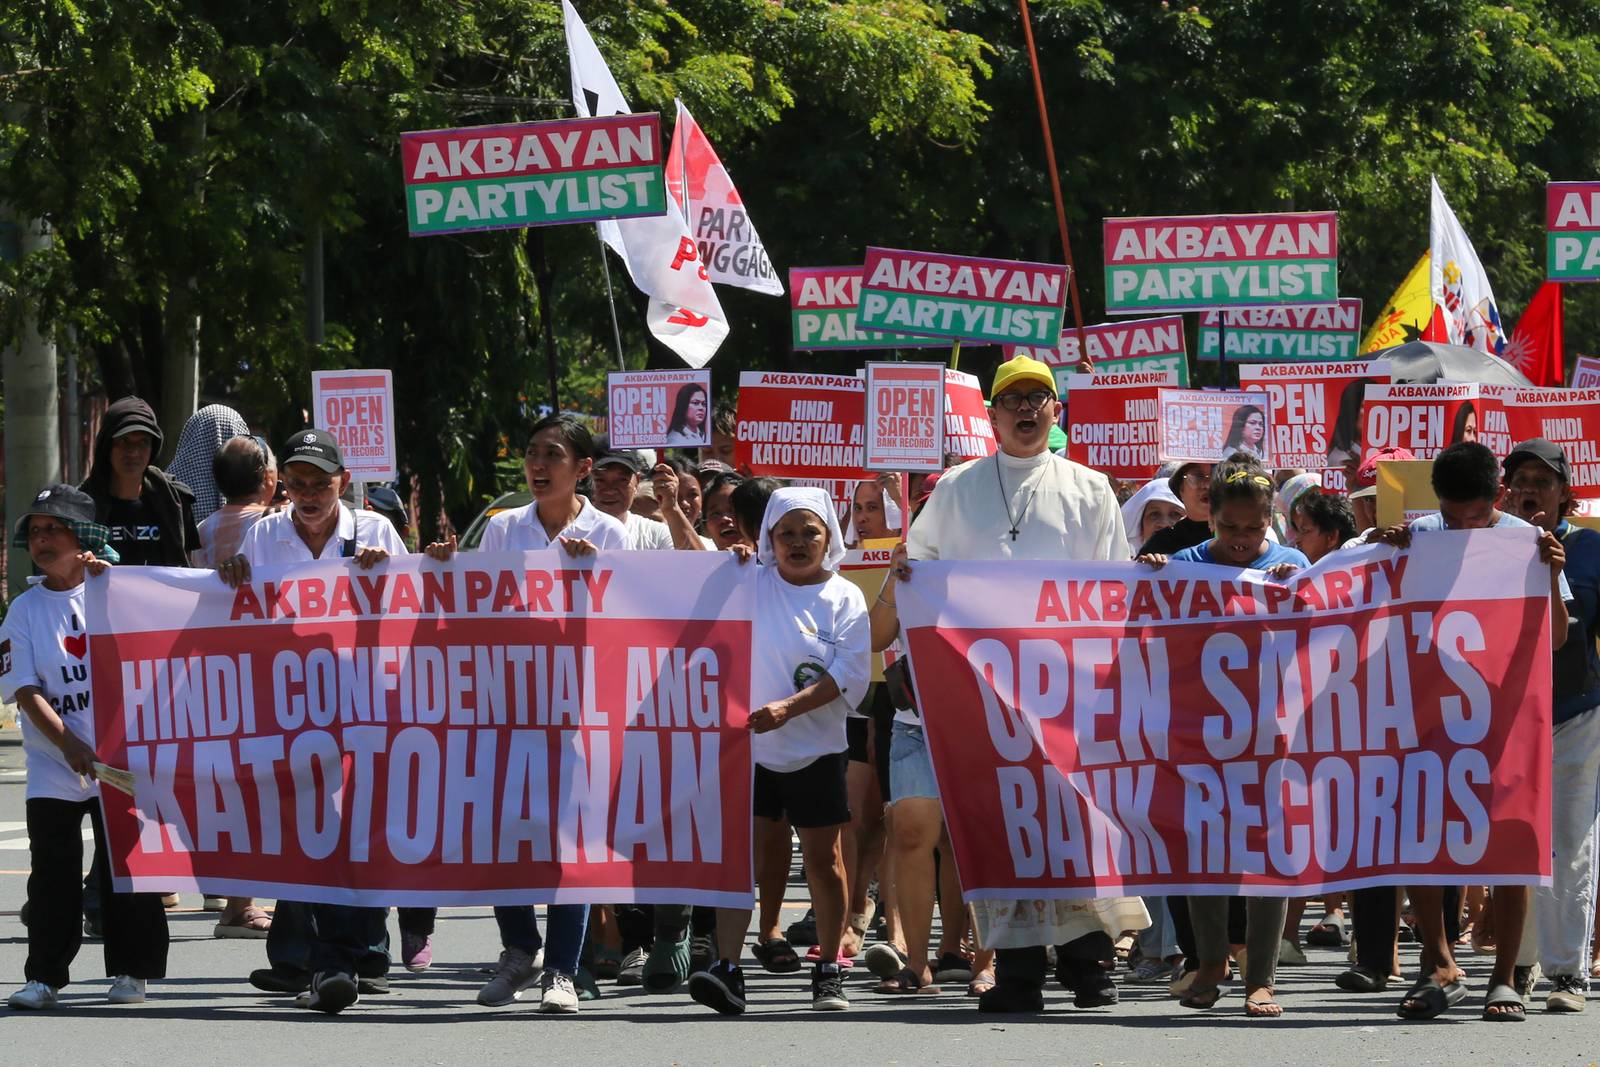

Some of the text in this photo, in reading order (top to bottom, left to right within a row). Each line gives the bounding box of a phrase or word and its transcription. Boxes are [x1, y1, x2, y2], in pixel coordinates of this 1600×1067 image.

[413, 125, 654, 179] AKBAYAN
[414, 172, 655, 225] PARTYLIST
[1555, 192, 1600, 227] A
[697, 207, 751, 243] PAR
[1112, 223, 1330, 261] AKBAYAN
[868, 257, 1061, 304] AKBAYAN
[1113, 264, 1329, 301] PARTYLIST
[863, 294, 1055, 340] PARTYLIST
[1204, 306, 1355, 329] AKBAYAN
[1203, 331, 1354, 357] PARTYLIST
[761, 374, 823, 386] AKBAYAN
[1091, 374, 1149, 386] AKBAYAN
[1150, 372, 1168, 383] PARTY
[1261, 363, 1369, 376] AKBAYAN PARTY
[612, 387, 667, 415] OPEN
[877, 388, 935, 416] OPEN
[1245, 383, 1326, 424] PEN
[1387, 385, 1470, 398] AKBAYAN PARTY
[1515, 392, 1567, 403] AKBAYAN
[326, 395, 384, 426] OPEN
[790, 400, 833, 422] HINDI
[1125, 399, 1158, 421] HINDI
[1167, 405, 1223, 431] OPEN
[614, 414, 667, 435] SARA'S
[737, 420, 845, 445] CONFIDENTIAL
[877, 416, 935, 437] SARA'S
[1367, 405, 1445, 448] OPEN
[1542, 418, 1583, 440] HINDI
[351, 446, 385, 457] RECORDS
[877, 438, 935, 448] BANK RECORDS
[1168, 430, 1223, 449] SARA'S
[752, 443, 864, 468] KATOTOHANAN
[1279, 453, 1329, 467] RECORDS
[230, 569, 613, 621] AKBAYAN PARTY
[1035, 555, 1409, 623] AKBAYAN PARTY
[121, 645, 720, 743] HINDI CONFIDENTIAL ANG
[966, 610, 1492, 766] OPEN SARA'S
[126, 726, 722, 865] KATOTOHANAN
[995, 747, 1492, 879] BANK RECORDS
